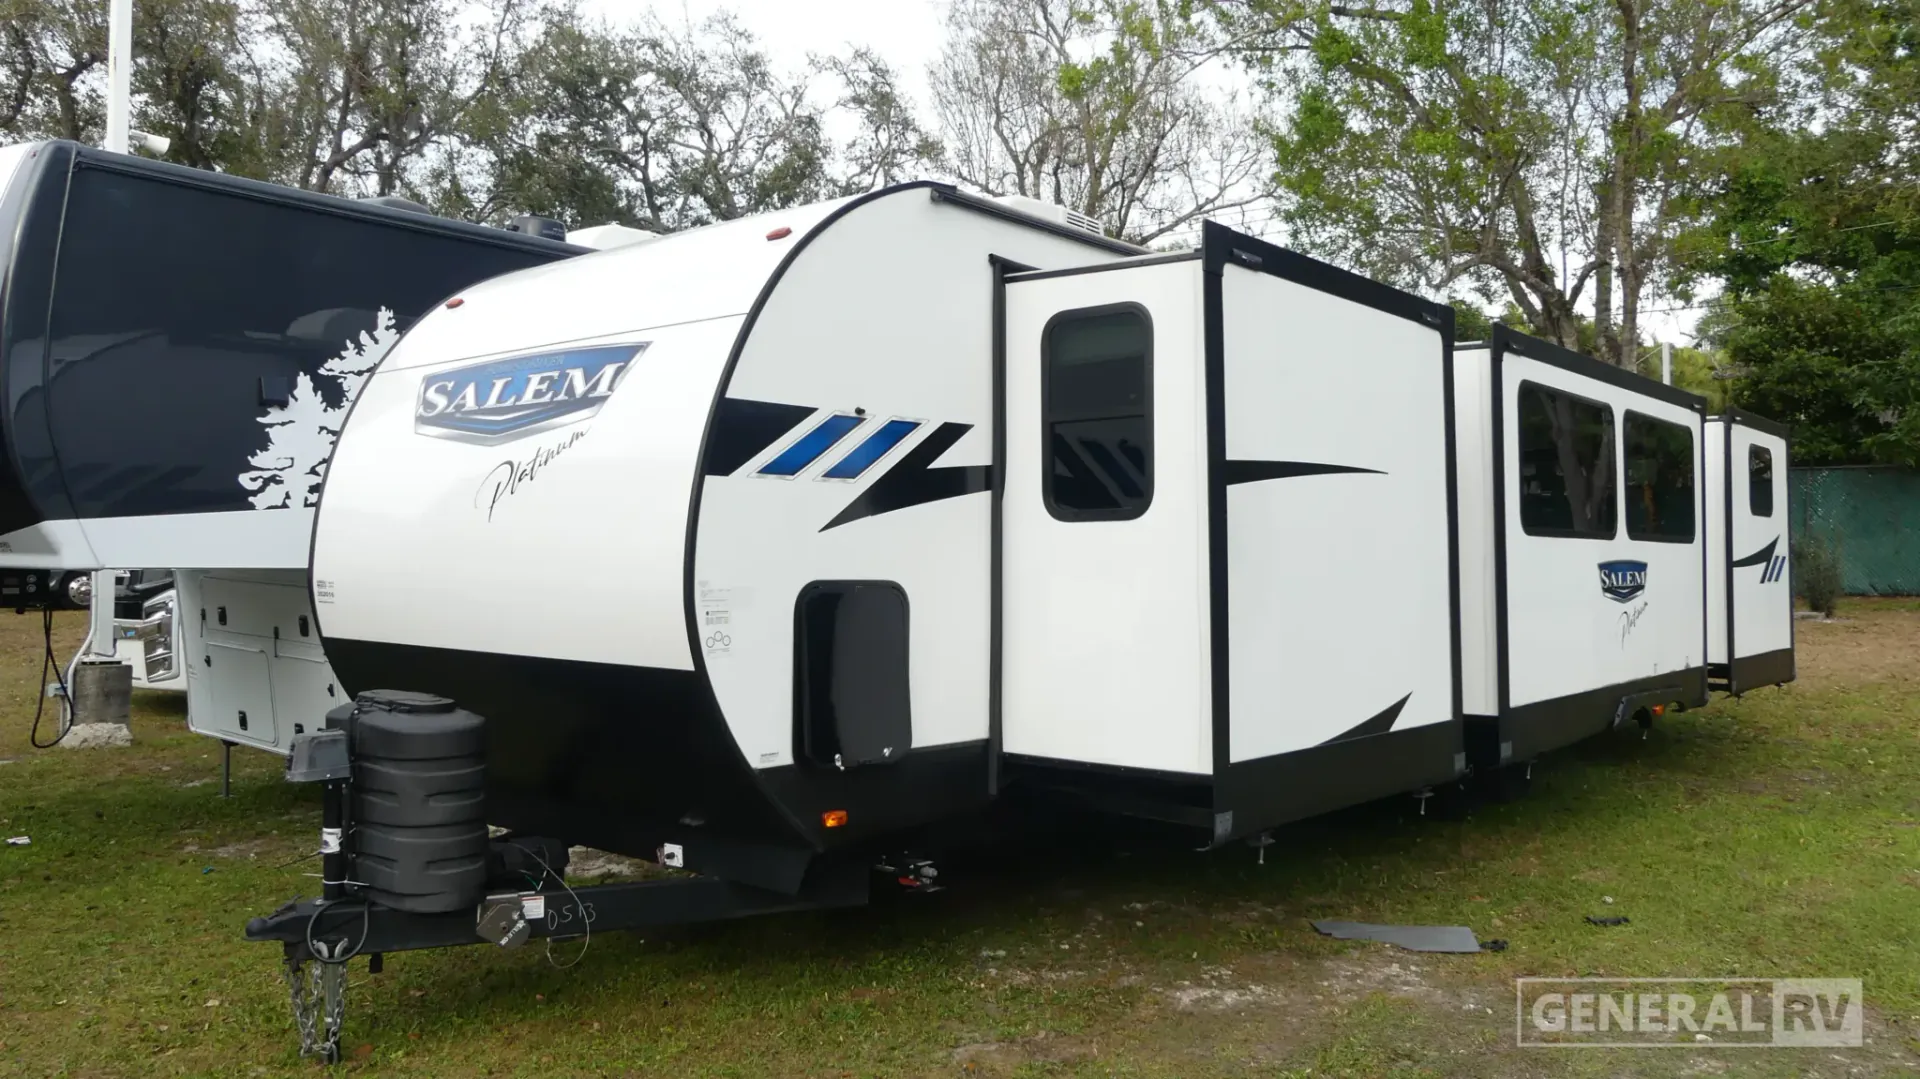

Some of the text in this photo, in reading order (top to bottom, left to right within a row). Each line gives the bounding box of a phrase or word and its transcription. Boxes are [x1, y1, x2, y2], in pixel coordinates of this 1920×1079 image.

[416, 362, 626, 417] SALEM
[474, 425, 592, 523] Platinum
[1601, 569, 1646, 588] SALEM
